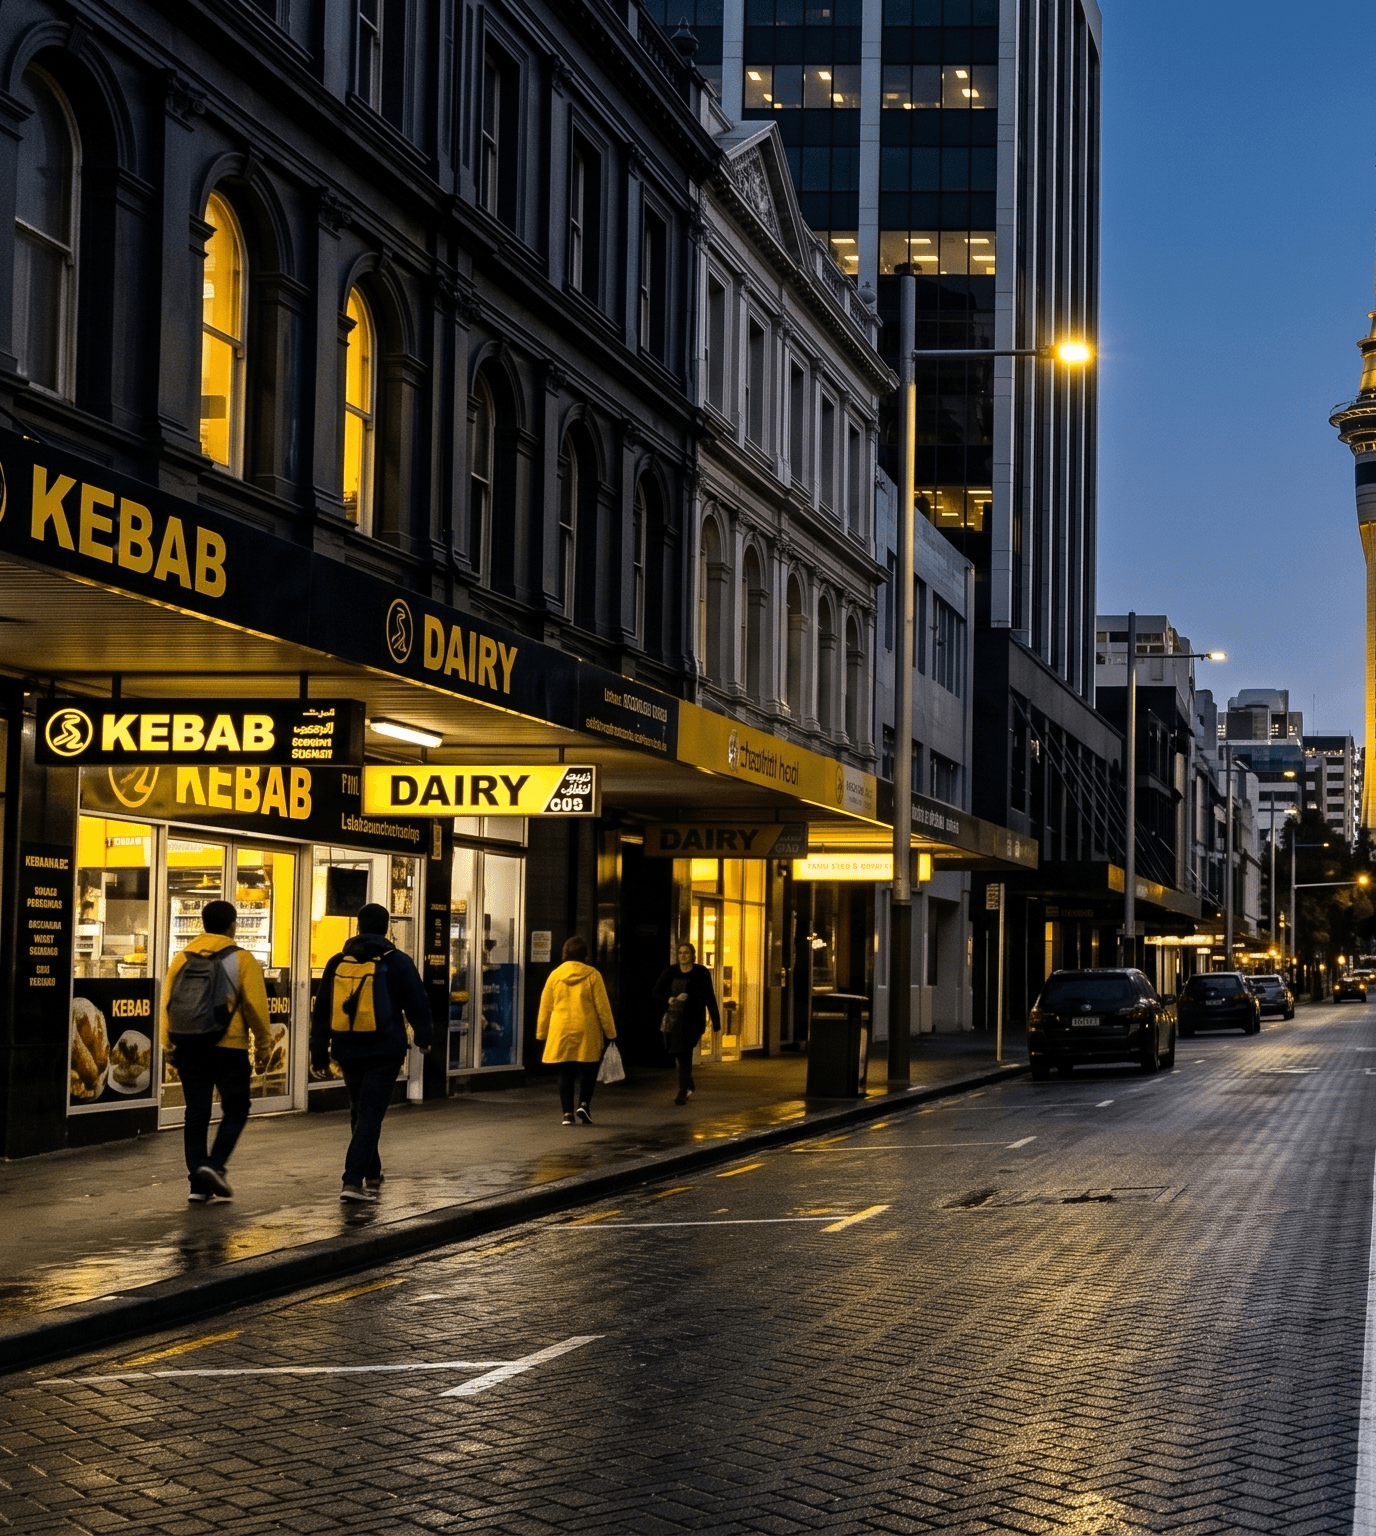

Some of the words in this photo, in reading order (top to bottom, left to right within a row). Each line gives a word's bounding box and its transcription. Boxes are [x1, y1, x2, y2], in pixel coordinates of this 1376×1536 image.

[31, 463, 226, 598] KEBAB
[423, 613, 518, 694] DAIRY
[101, 714, 275, 751] KEBAB
[176, 766, 312, 820] KEBAB
[390, 775, 531, 806] DAIRY
[660, 829, 759, 850] DAIRY
[112, 999, 151, 1017] KEBAB
